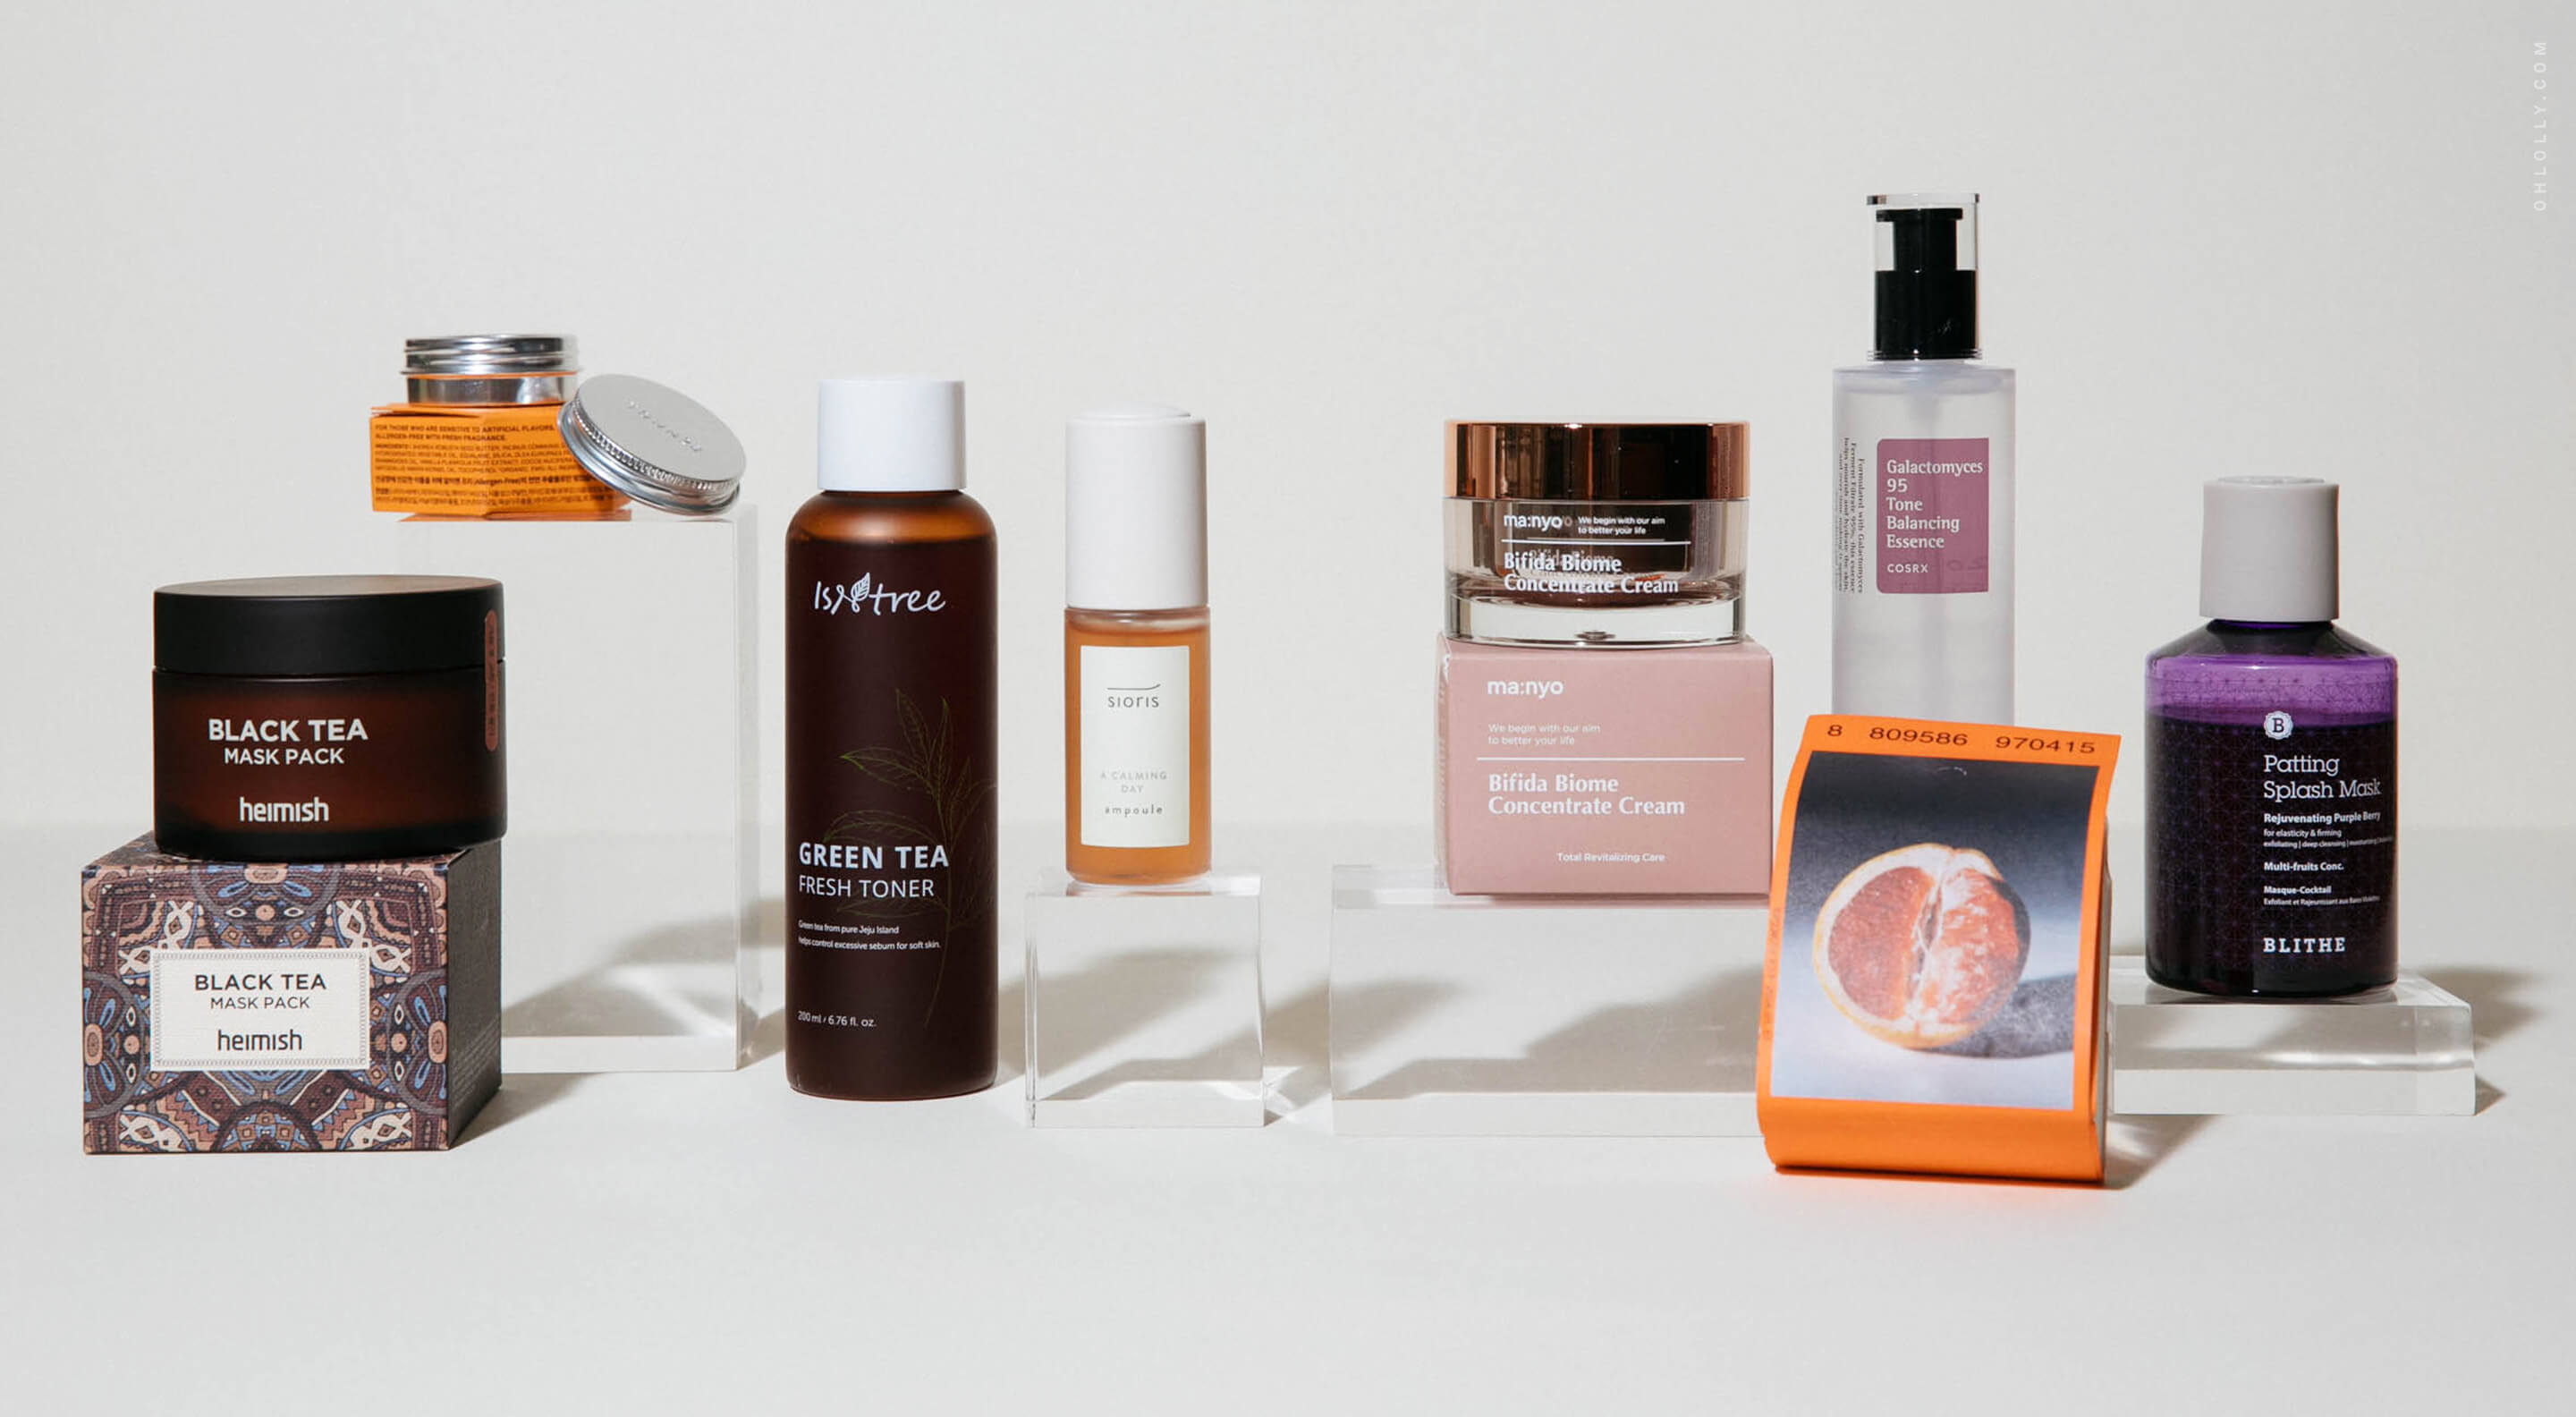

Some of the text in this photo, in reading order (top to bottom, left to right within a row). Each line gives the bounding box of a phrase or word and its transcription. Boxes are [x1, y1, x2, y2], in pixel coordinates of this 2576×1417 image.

[1886, 460, 1983, 477] Galactomyces
[1887, 479, 1908, 493] 95
[1886, 497, 1923, 511] Tone
[1504, 514, 1563, 532] ma:nyo
[1578, 517, 1591, 525] We
[1593, 516, 1616, 526] begin
[1617, 517, 1635, 525] with
[1651, 517, 1665, 525] aim
[1857, 512, 1866, 531] with
[1886, 515, 1961, 532] Balancing
[1614, 528, 1632, 536] your
[1886, 534, 1945, 548] Essence
[1504, 552, 1622, 573] Bifida Biome
[1887, 564, 1928, 573] COSRX
[1504, 573, 1679, 594] Concentrate Cream
[1487, 680, 1563, 700] ma:nyo
[208, 719, 368, 742] BLACK TEA
[1488, 723, 1601, 734] We begin with our aim
[2272, 718, 2284, 733] B
[1488, 735, 1575, 746] to better your life
[1827, 725, 2095, 754] 8 809586 970415
[225, 748, 344, 765] MASK PACK
[2264, 755, 2340, 776] Patting
[1100, 771, 1167, 780] A CALMING
[1488, 773, 1620, 793] Bifida Biome
[1121, 785, 1144, 793] DAY
[2264, 778, 2381, 802] Splash Mask
[240, 797, 329, 822] heimish
[1105, 804, 1163, 818] ampoule
[1488, 795, 1686, 815] Concentrate Cream
[2264, 811, 2380, 825] Rejuvenating Purple Berry
[2264, 829, 2275, 837] for
[2275, 829, 2309, 838] elasticity
[2317, 829, 2342, 838] firming
[799, 842, 949, 870] GREEN TEA
[1557, 853, 1665, 863] Total Revitalizing Care
[2264, 861, 2344, 871] Multi-fruits Conc.
[799, 875, 935, 898] FRESH TONER
[2264, 886, 2332, 895] Masque-Cocktail
[2264, 897, 2292, 905] Exfoliant
[798, 920, 900, 936] Green tea from pure Jeju Island
[798, 936, 941, 950] helps control excessive sebum for soft skin.
[2263, 938, 2345, 953] BLITHE
[195, 974, 326, 990] BLACK TEA
[210, 997, 309, 1009] MASK PACK
[797, 1011, 810, 1022] 200
[811, 1014, 822, 1023] ml
[828, 1014, 848, 1026] 6.76
[850, 1016, 859, 1027] fl.
[860, 1019, 877, 1027] oz.
[217, 1029, 302, 1051] heimish
